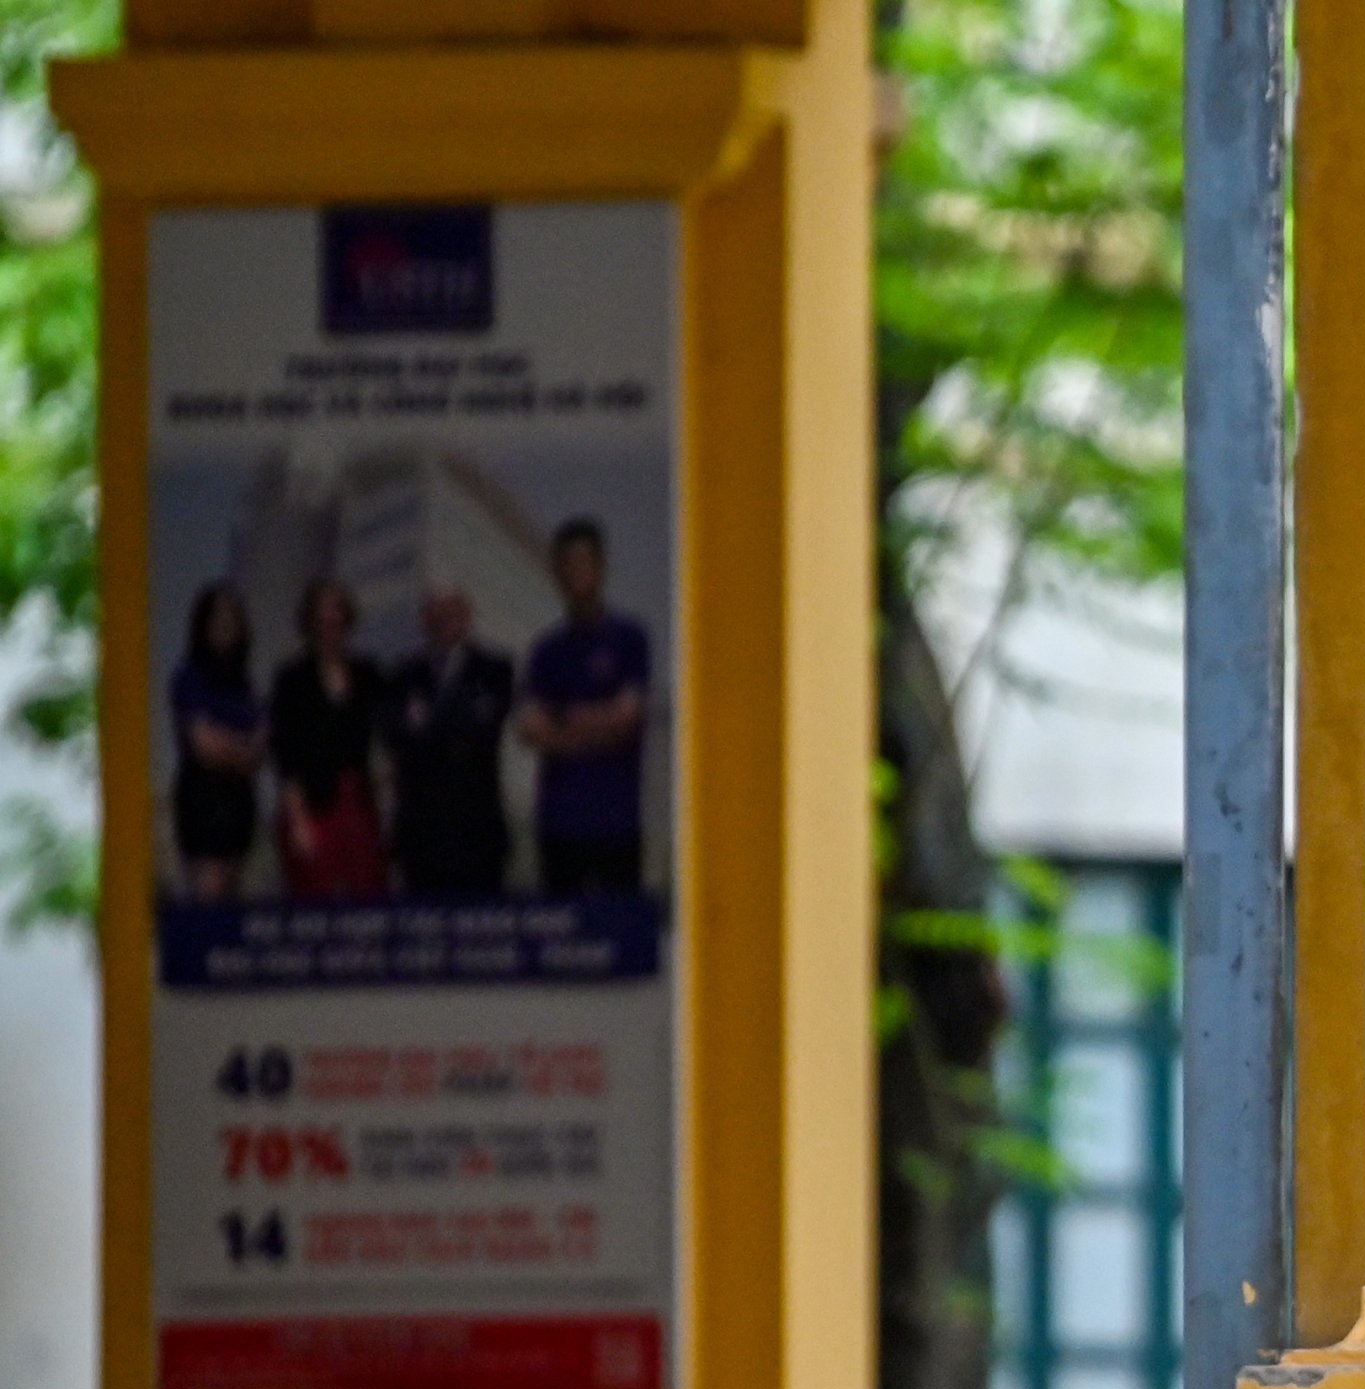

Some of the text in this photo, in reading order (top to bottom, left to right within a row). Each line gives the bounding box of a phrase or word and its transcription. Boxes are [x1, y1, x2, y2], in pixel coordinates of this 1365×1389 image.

[217, 1047, 294, 1100] 40
[221, 1126, 348, 1182] 70%
[220, 1209, 287, 1263] 14
